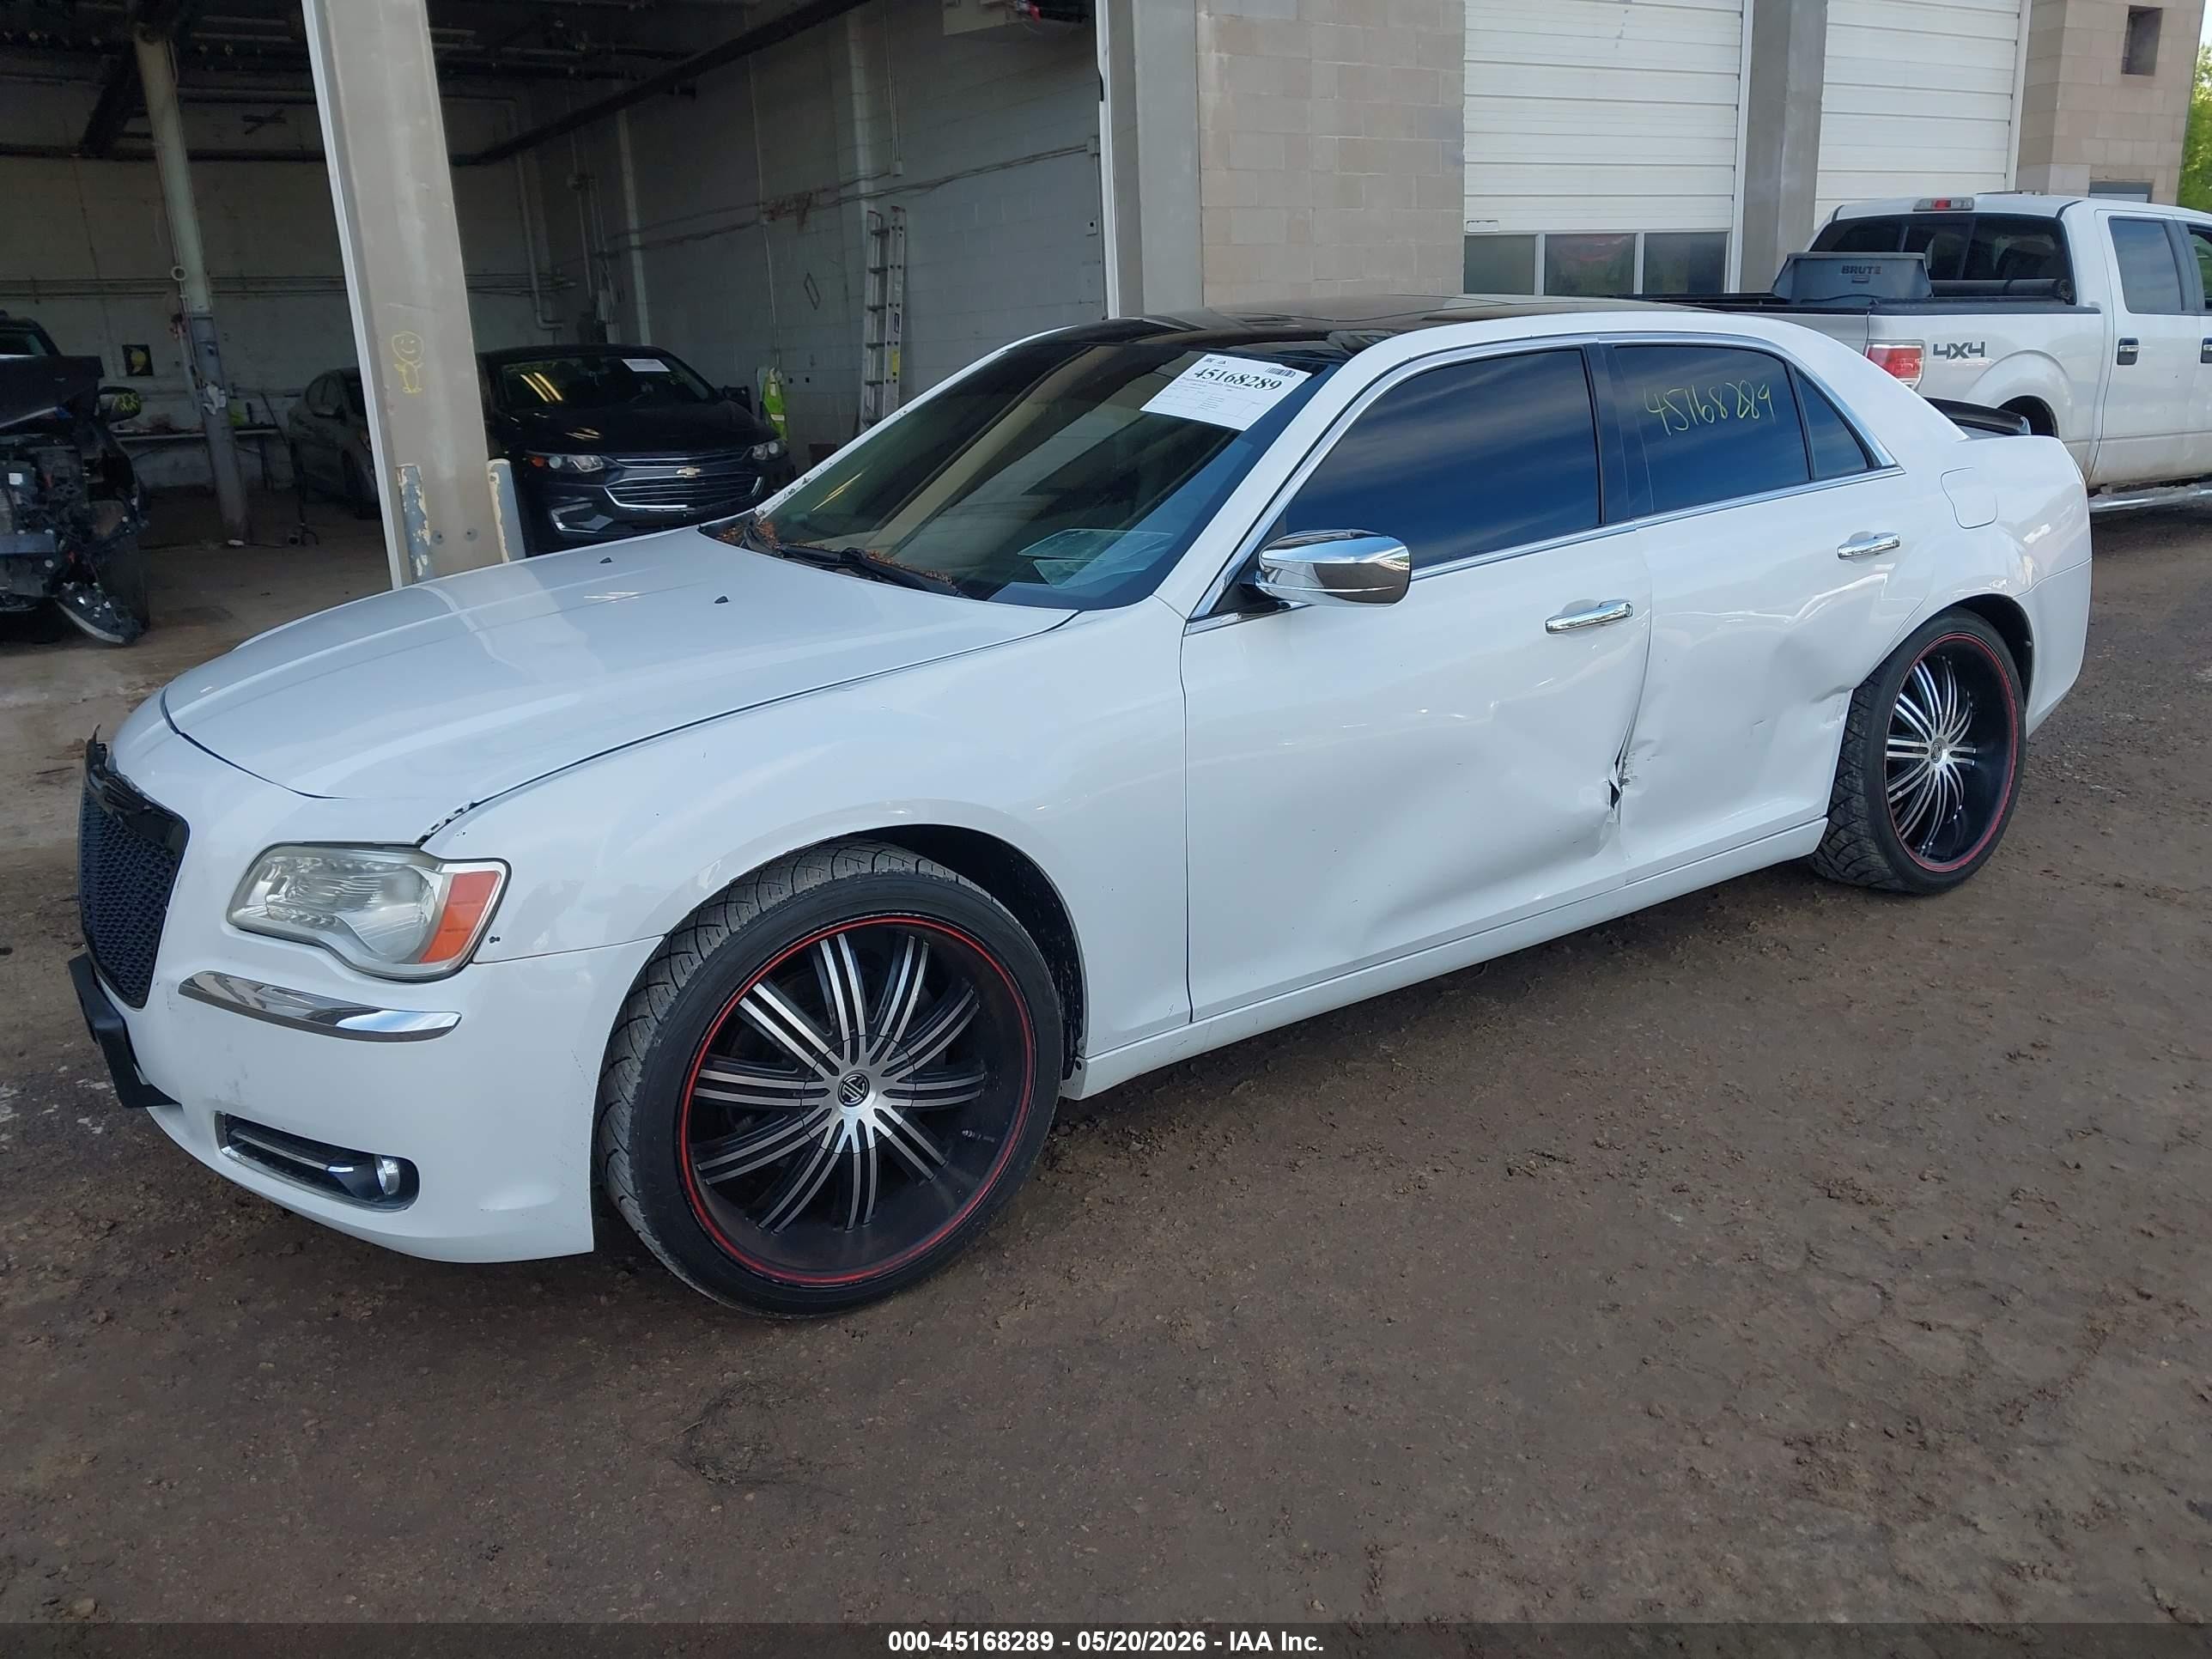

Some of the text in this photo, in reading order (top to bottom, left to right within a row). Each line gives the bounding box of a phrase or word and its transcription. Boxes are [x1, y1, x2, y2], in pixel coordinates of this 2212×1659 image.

[1841, 264, 1882, 275] BRUTE
[1194, 368, 1283, 391] 45168289
[1644, 380, 1777, 436] 45168289
